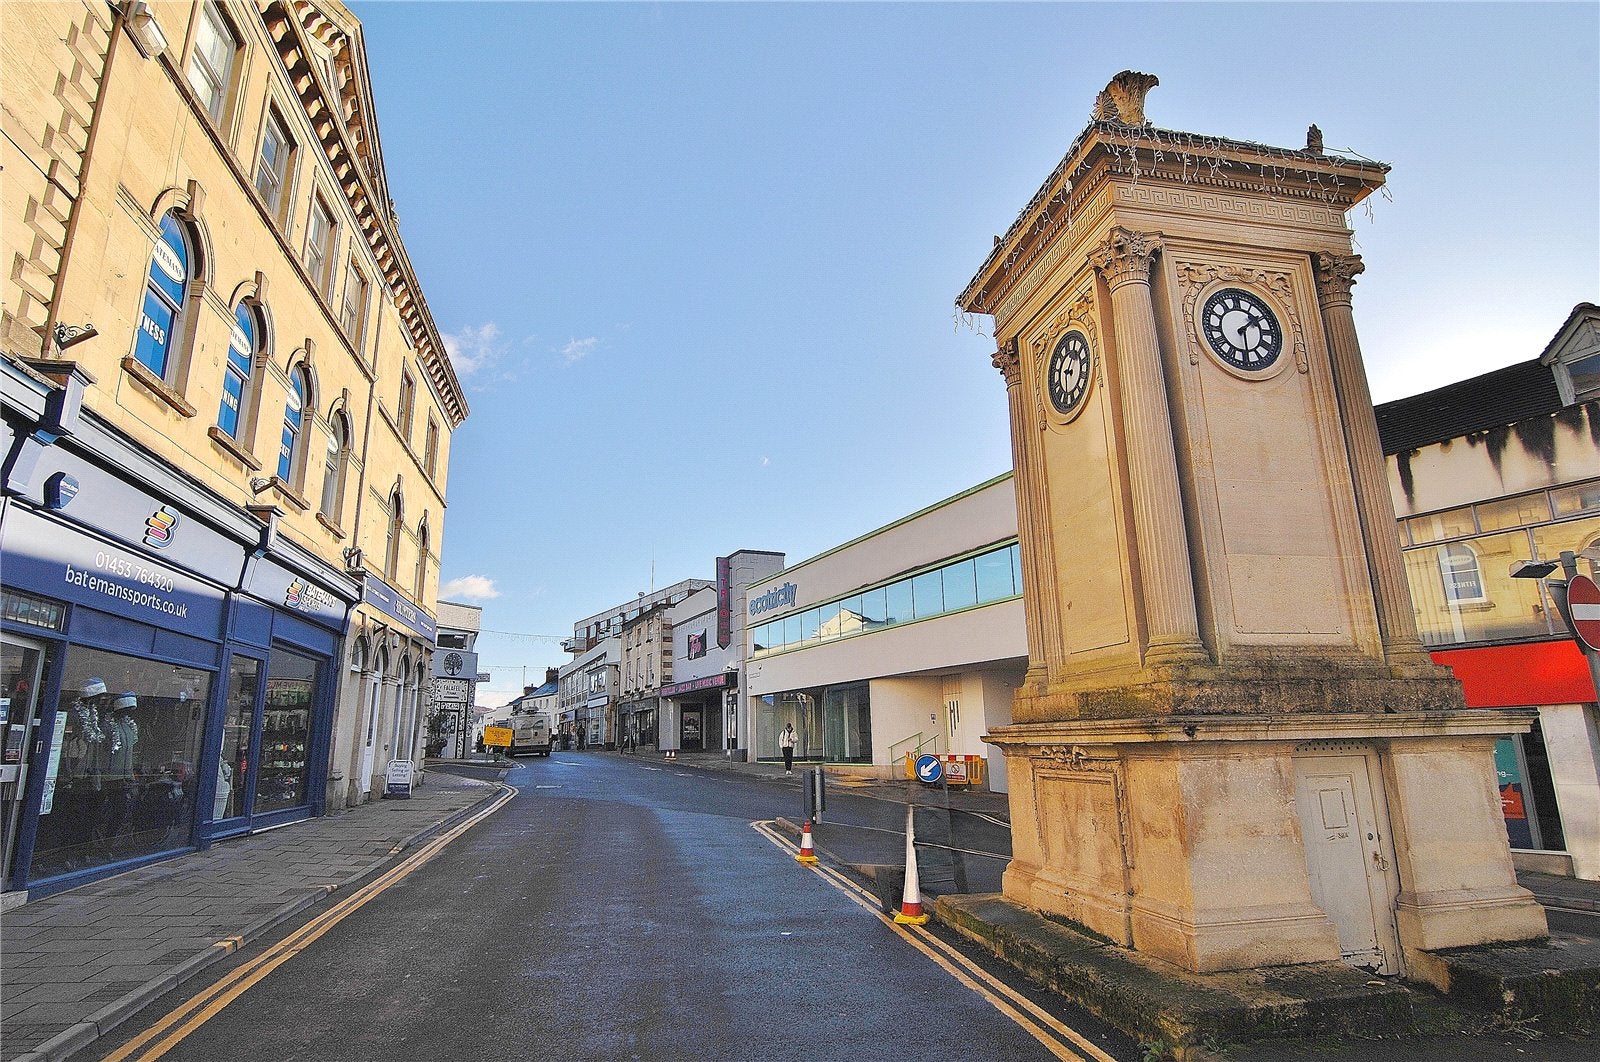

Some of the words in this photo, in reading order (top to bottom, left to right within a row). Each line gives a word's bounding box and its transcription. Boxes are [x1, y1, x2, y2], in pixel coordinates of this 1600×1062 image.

[64, 564, 188, 618] batemanssports.co.uk
[95, 551, 131, 577] 01453
[134, 565, 174, 593] 764320
[749, 581, 798, 616] ecotricity
